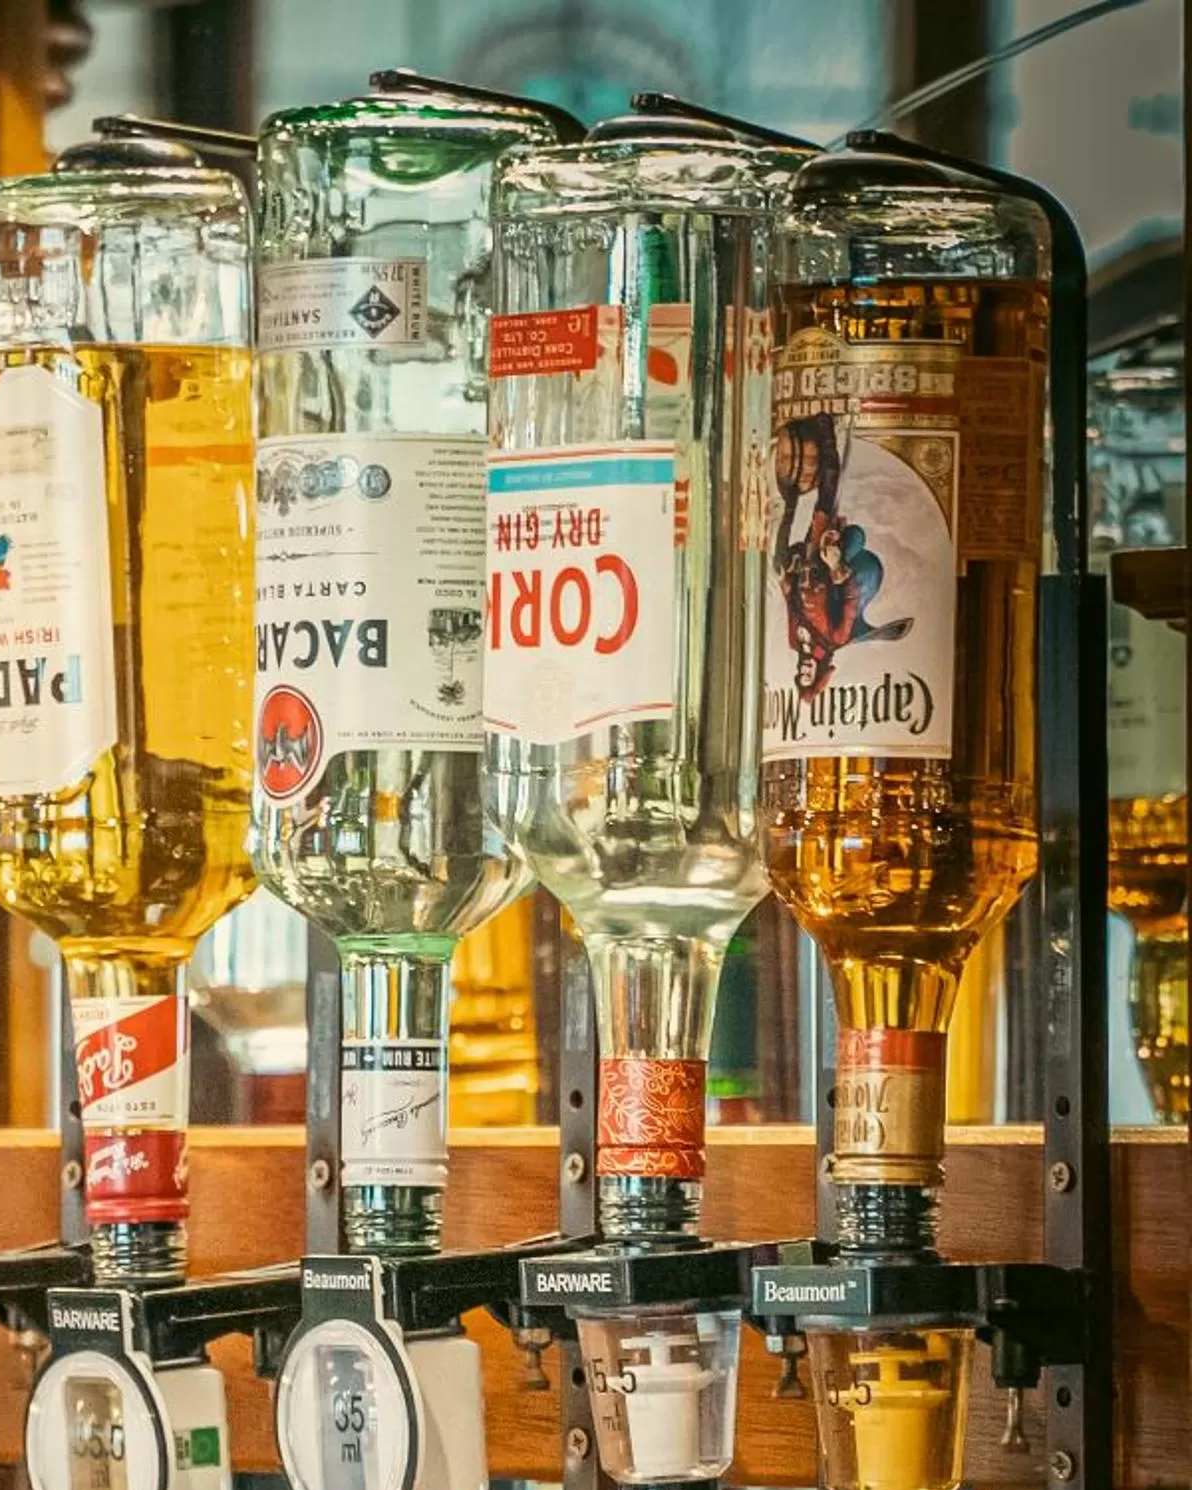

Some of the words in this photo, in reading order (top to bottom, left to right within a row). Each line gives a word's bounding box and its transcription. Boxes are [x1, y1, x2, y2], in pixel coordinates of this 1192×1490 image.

[800, 364, 917, 397] SPICED
[498, 512, 540, 551] GIN
[552, 509, 601, 548] DRY
[292, 581, 367, 598] CARTA
[14, 627, 60, 645] IRISH
[809, 672, 934, 739] Captain
[302, 1267, 372, 1291] Beaumont
[535, 1271, 612, 1294] BARWARE
[52, 1308, 120, 1333] BARWARE
